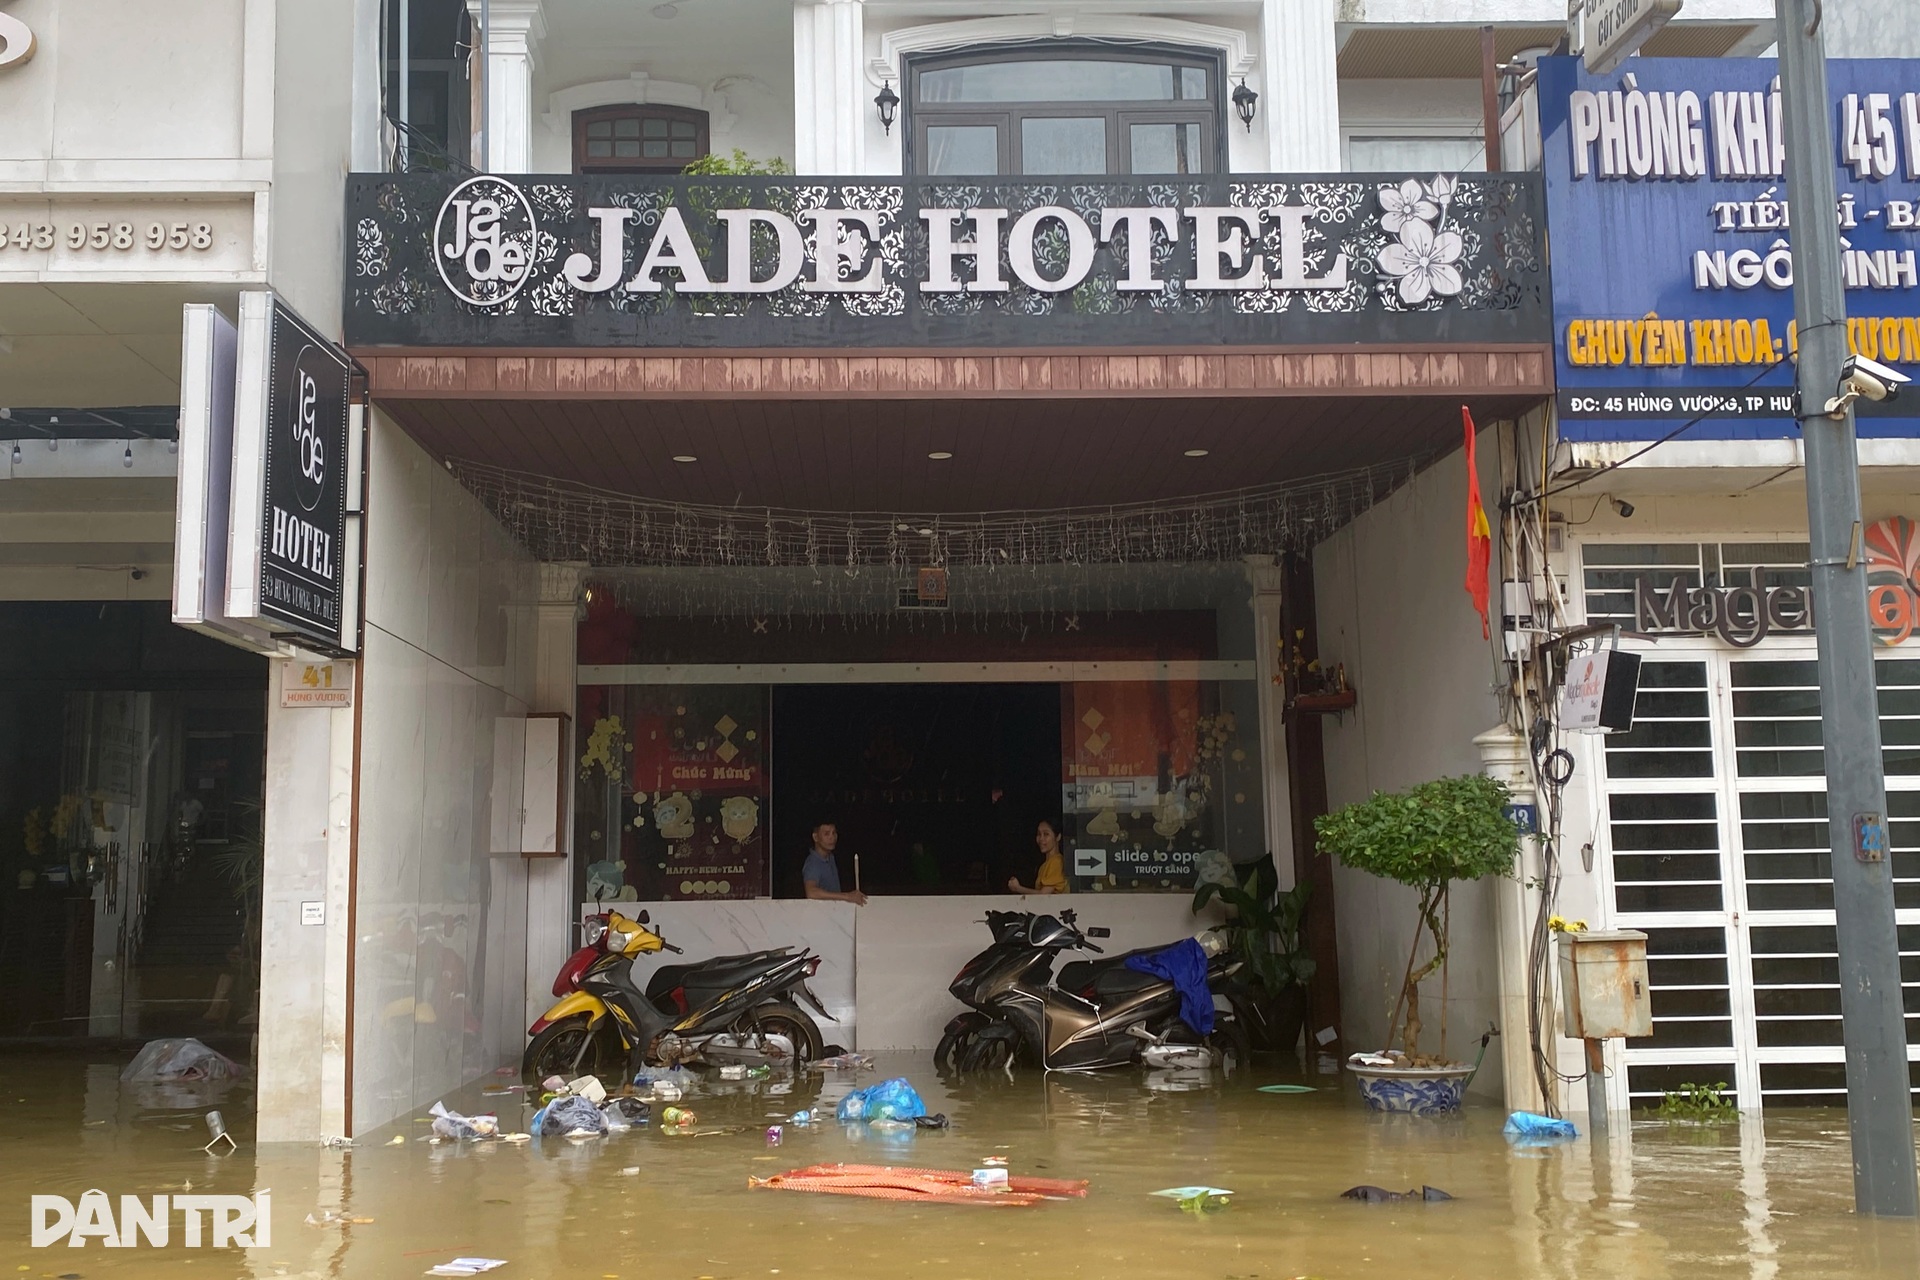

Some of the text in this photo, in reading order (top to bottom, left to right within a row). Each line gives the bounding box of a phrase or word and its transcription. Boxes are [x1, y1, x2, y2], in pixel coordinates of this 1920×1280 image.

[1570, 72, 1706, 178] PHÒNG
[1710, 74, 1787, 179] KHÁ
[1842, 93, 1896, 179] 45
[1714, 187, 1790, 230] TIẾ
[67, 222, 134, 250] 958
[145, 222, 212, 250] 958
[563, 206, 1347, 293] JADE HOTEL
[1694, 236, 1918, 289] NGÔ ÌNH
[1568, 311, 1685, 366] CHUYÊN
[1692, 318, 1783, 366] KHOA:
[1571, 391, 1802, 414] ĐC: 45 HÙNG VƯƠNG, TP HU
[271, 505, 333, 580] HOTEL
[302, 665, 333, 688] 41
[672, 766, 751, 781] Chúc Mừng
[666, 865, 745, 875] HAPPY NEW YEAR
[1114, 849, 1201, 864] slide to ope
